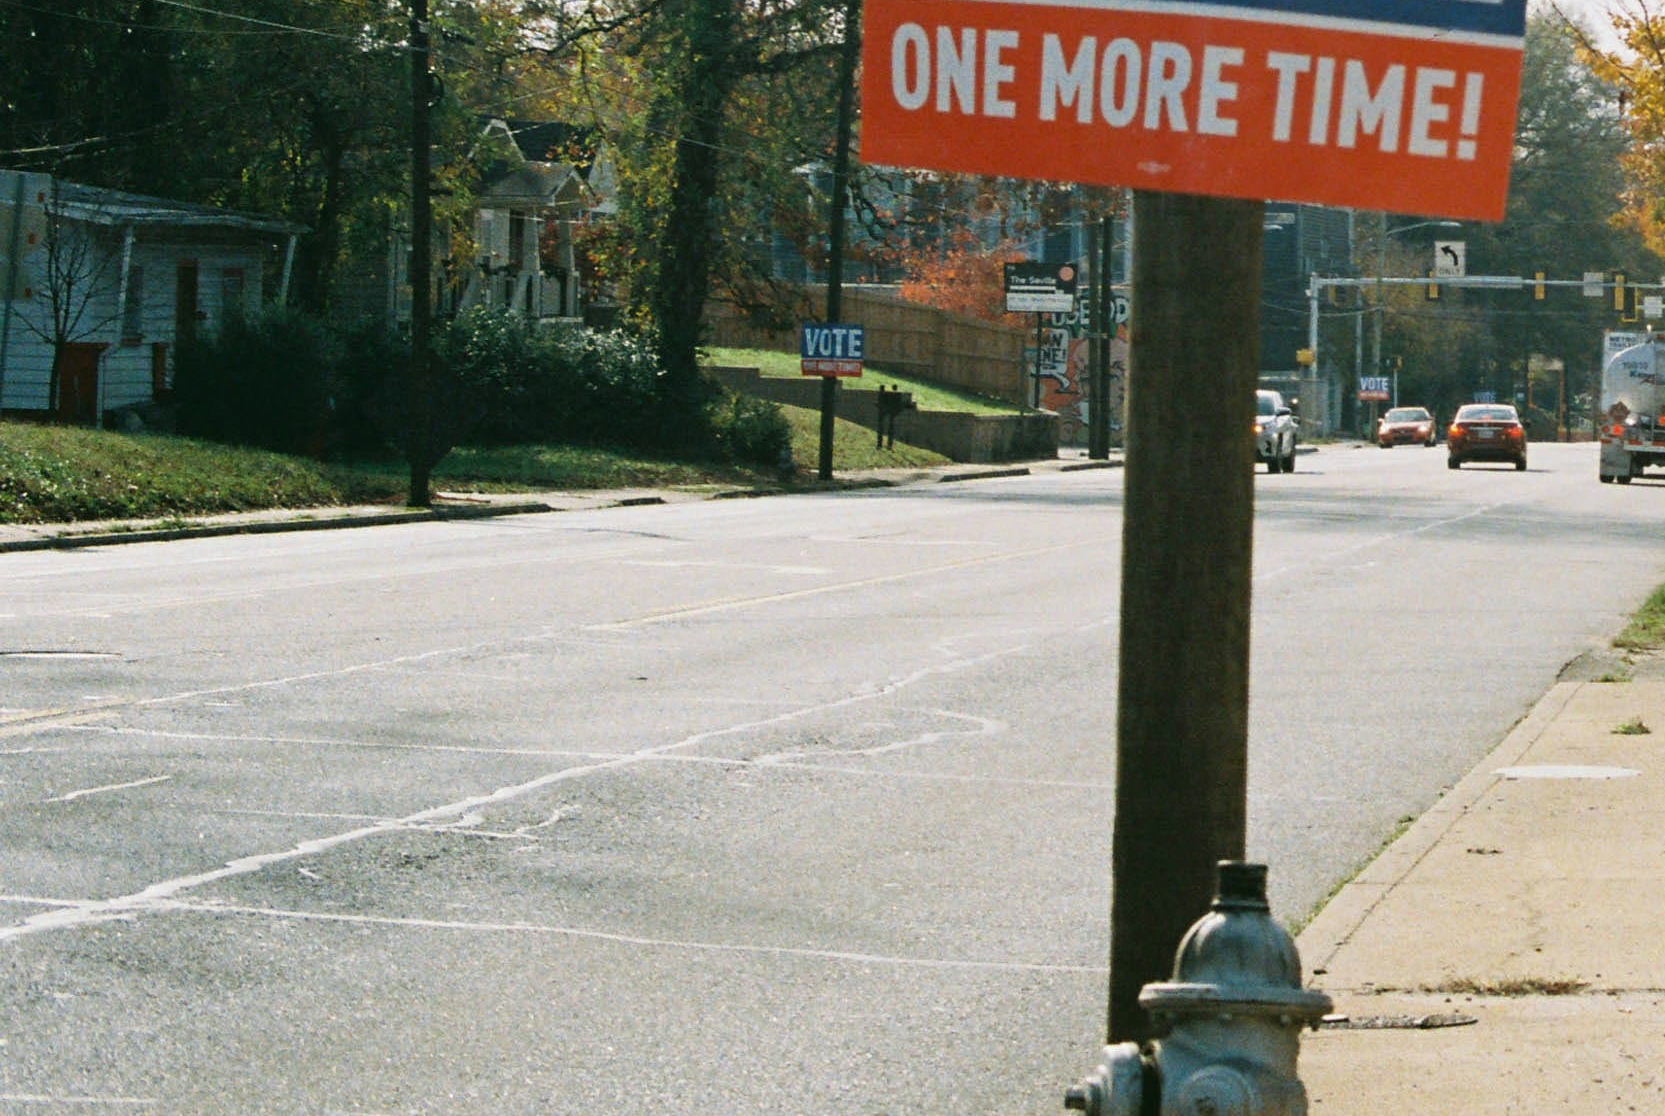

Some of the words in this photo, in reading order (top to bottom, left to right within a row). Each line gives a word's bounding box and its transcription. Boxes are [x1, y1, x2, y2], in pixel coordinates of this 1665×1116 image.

[891, 22, 1018, 119] ONE
[1038, 32, 1245, 138] MORE
[1266, 50, 1484, 161] TIME!
[1438, 268, 1462, 276] ONLY
[804, 328, 863, 357] VOTE
[1360, 377, 1389, 391] VOTE
